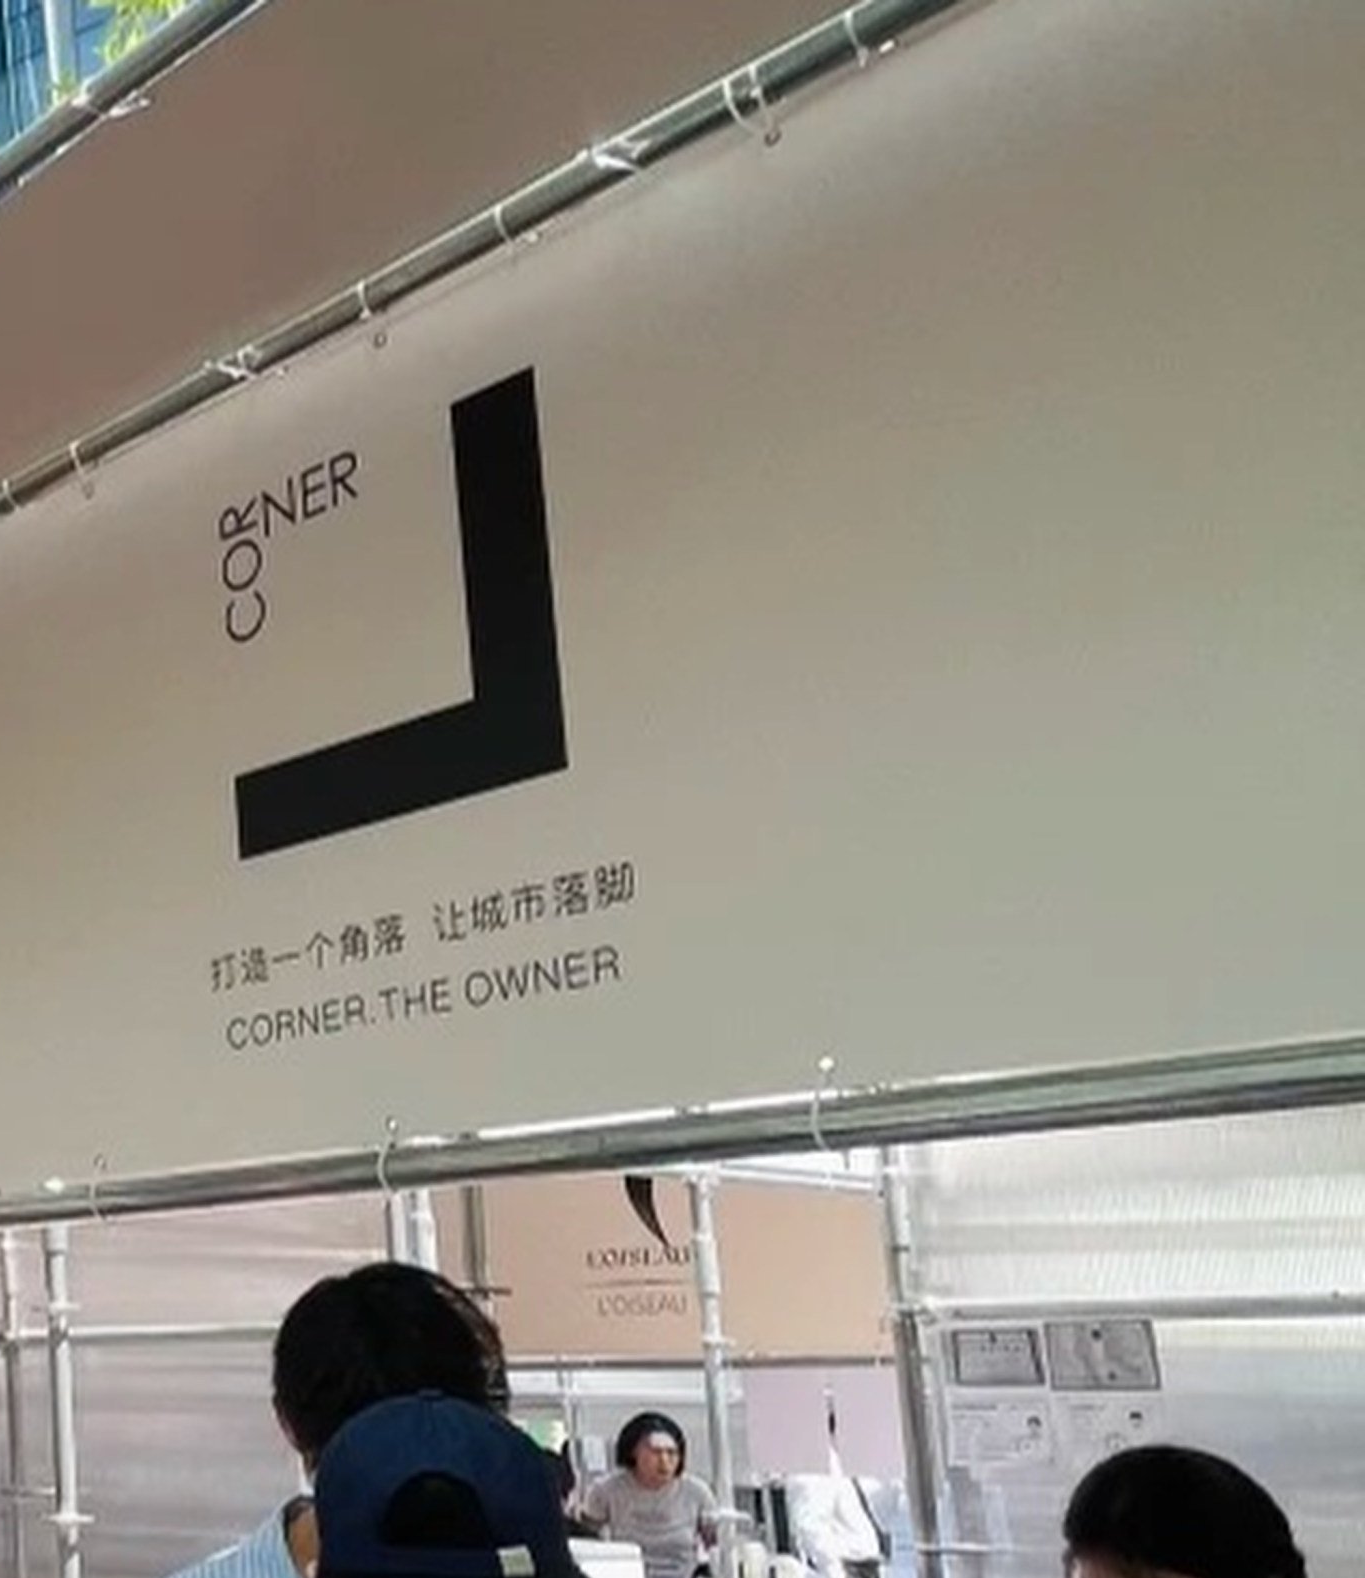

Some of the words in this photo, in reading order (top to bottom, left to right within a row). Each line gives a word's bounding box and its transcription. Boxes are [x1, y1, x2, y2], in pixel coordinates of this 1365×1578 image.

[219, 451, 358, 643] CORNER
[211, 913, 406, 993] 打造一个角落
[432, 861, 635, 942] 让城市落脚
[464, 945, 621, 1010] OWNER
